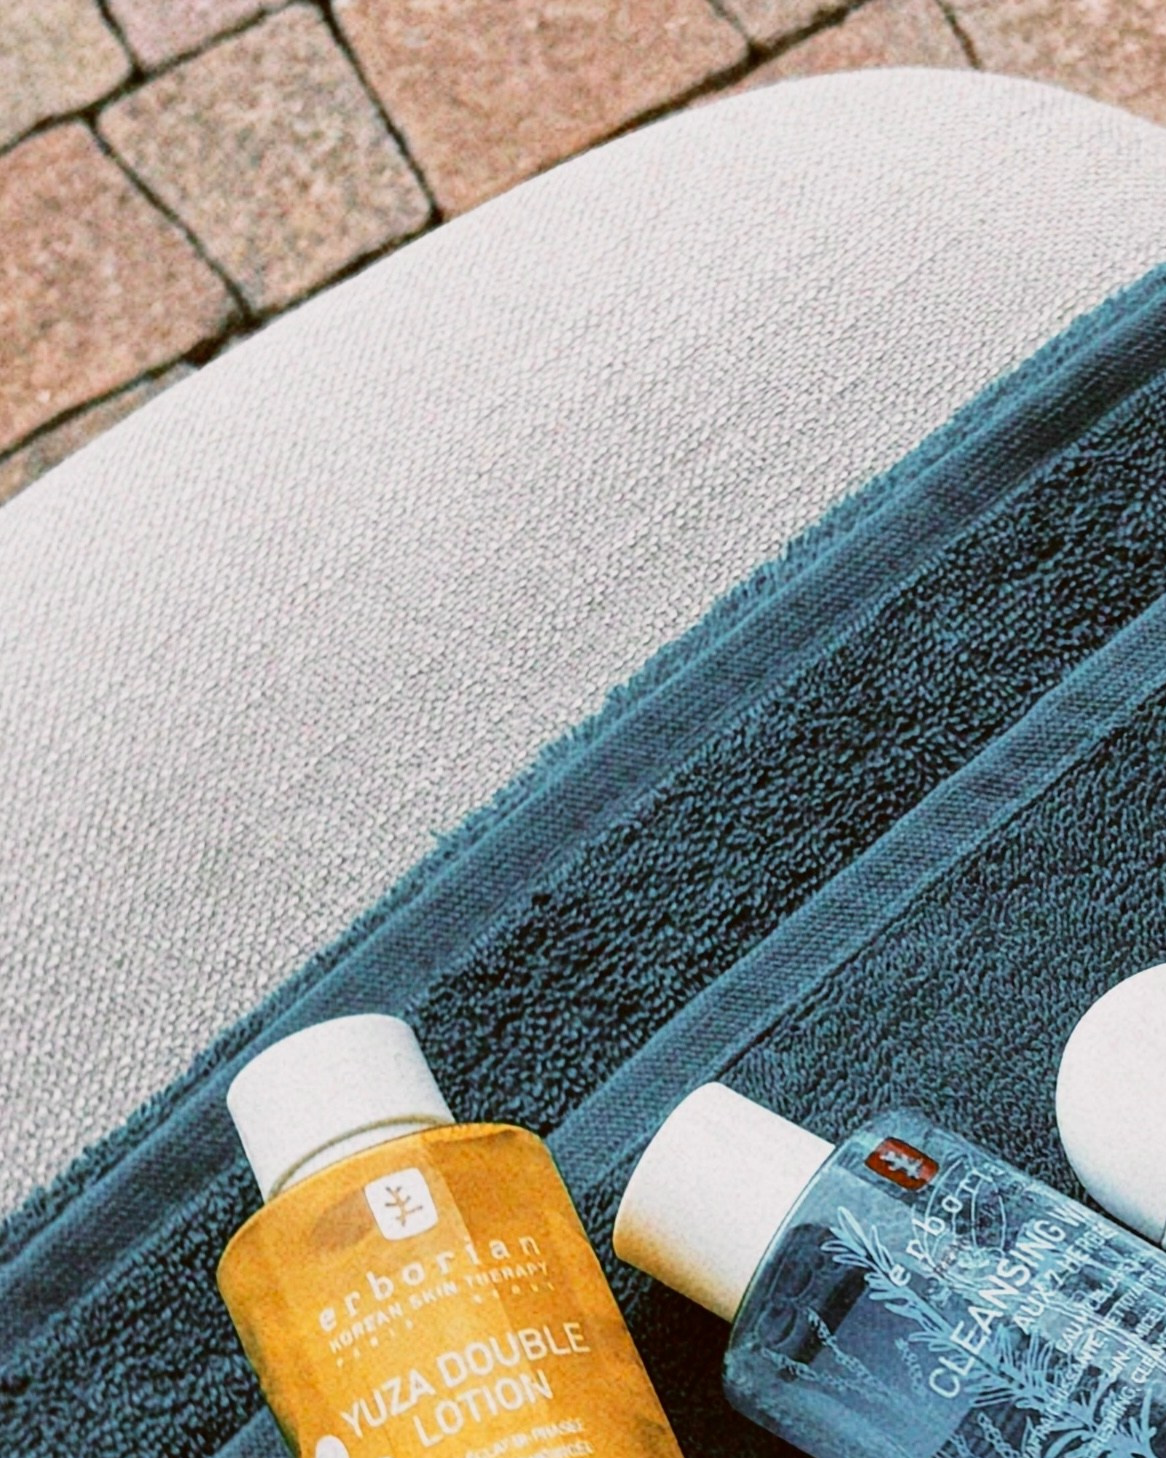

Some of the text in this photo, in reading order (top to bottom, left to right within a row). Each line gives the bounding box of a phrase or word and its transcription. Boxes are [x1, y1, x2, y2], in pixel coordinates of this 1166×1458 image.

[319, 1236, 540, 1332] erborian
[329, 1302, 403, 1354] KOREAN
[409, 1281, 459, 1310] SKIN
[465, 1260, 548, 1288] THERAPY
[928, 1219, 1066, 1399] CLEANSING
[1012, 1282, 1054, 1335] AUX
[340, 1368, 436, 1439] YUZA
[436, 1322, 591, 1388] DOUBLE
[1054, 1320, 1083, 1355] EAU
[412, 1369, 554, 1448] LOTION
